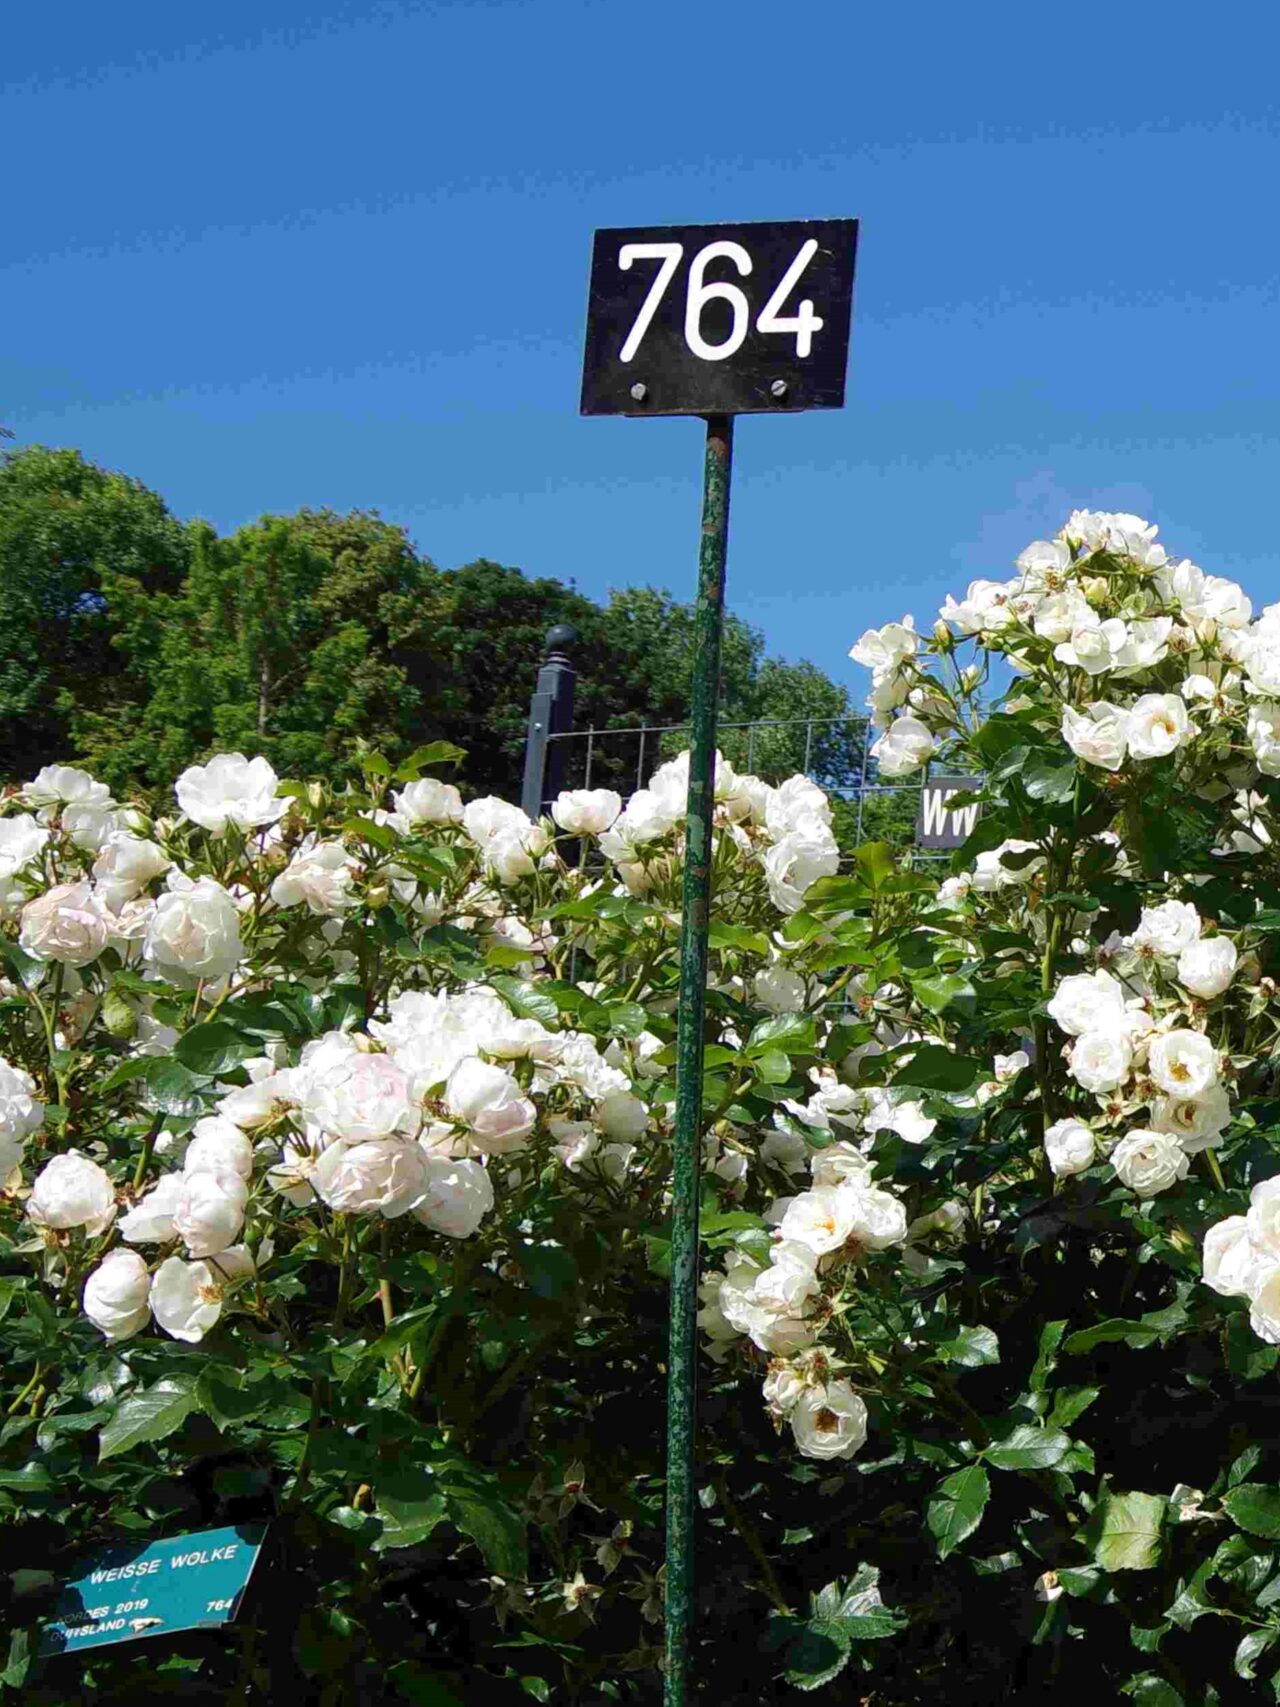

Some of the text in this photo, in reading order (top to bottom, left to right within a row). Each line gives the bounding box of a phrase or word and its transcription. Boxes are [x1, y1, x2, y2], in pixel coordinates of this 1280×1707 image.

[618, 239, 824, 363] 764
[91, 1544, 239, 1585] WEISSE WOLKE
[114, 1598, 150, 1615] 2019
[206, 1597, 233, 1613] 764
